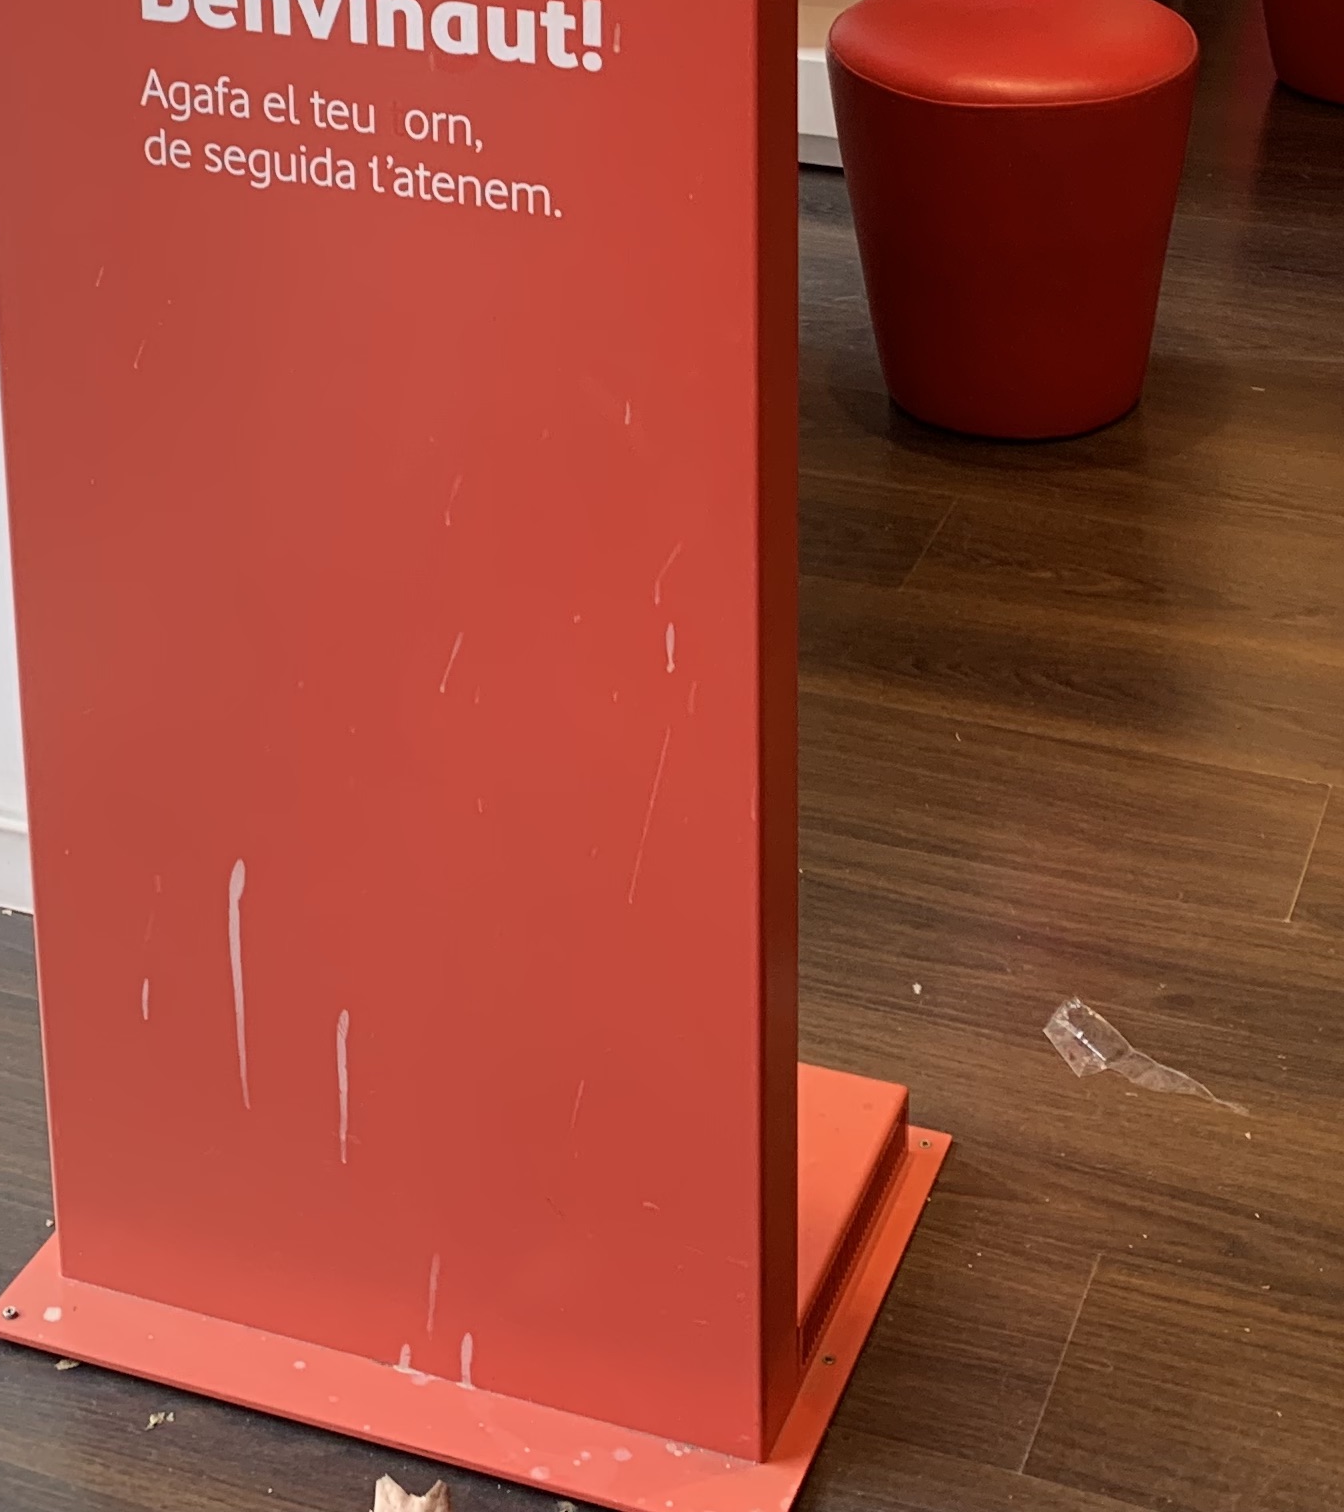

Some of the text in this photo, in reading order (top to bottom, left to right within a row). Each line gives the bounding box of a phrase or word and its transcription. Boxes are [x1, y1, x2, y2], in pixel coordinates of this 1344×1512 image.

[140, 68, 250, 123] Agafa
[263, 84, 302, 126] el
[309, 96, 376, 135] teu
[144, 128, 563, 219] de seguida t'atenem.
